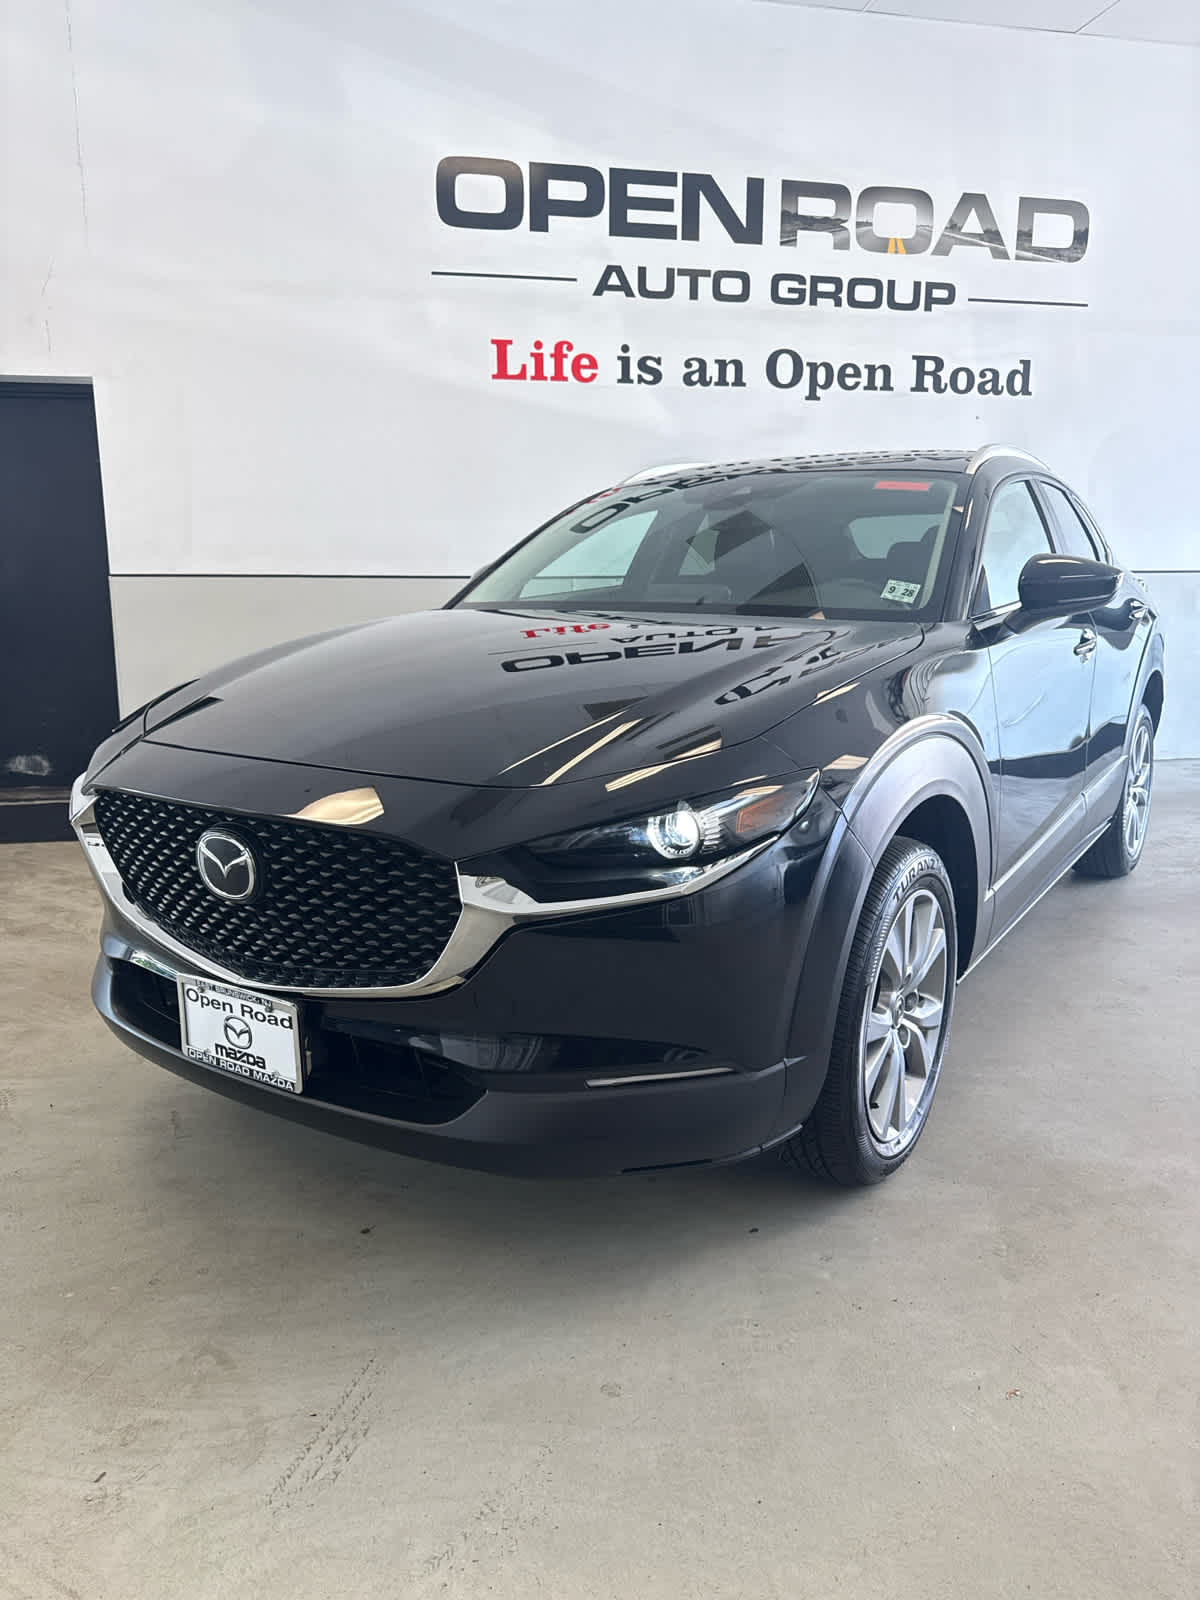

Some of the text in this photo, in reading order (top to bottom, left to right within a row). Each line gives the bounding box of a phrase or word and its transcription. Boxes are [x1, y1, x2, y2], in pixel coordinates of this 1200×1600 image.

[436, 156, 1090, 263] OPEN ROAD
[593, 265, 955, 312] AUTO GROUP
[491, 339, 1033, 401] Life is an Open Road
[186, 988, 293, 1029] Open Road
[189, 1048, 294, 1091] OPEN ROAD MAZDA
